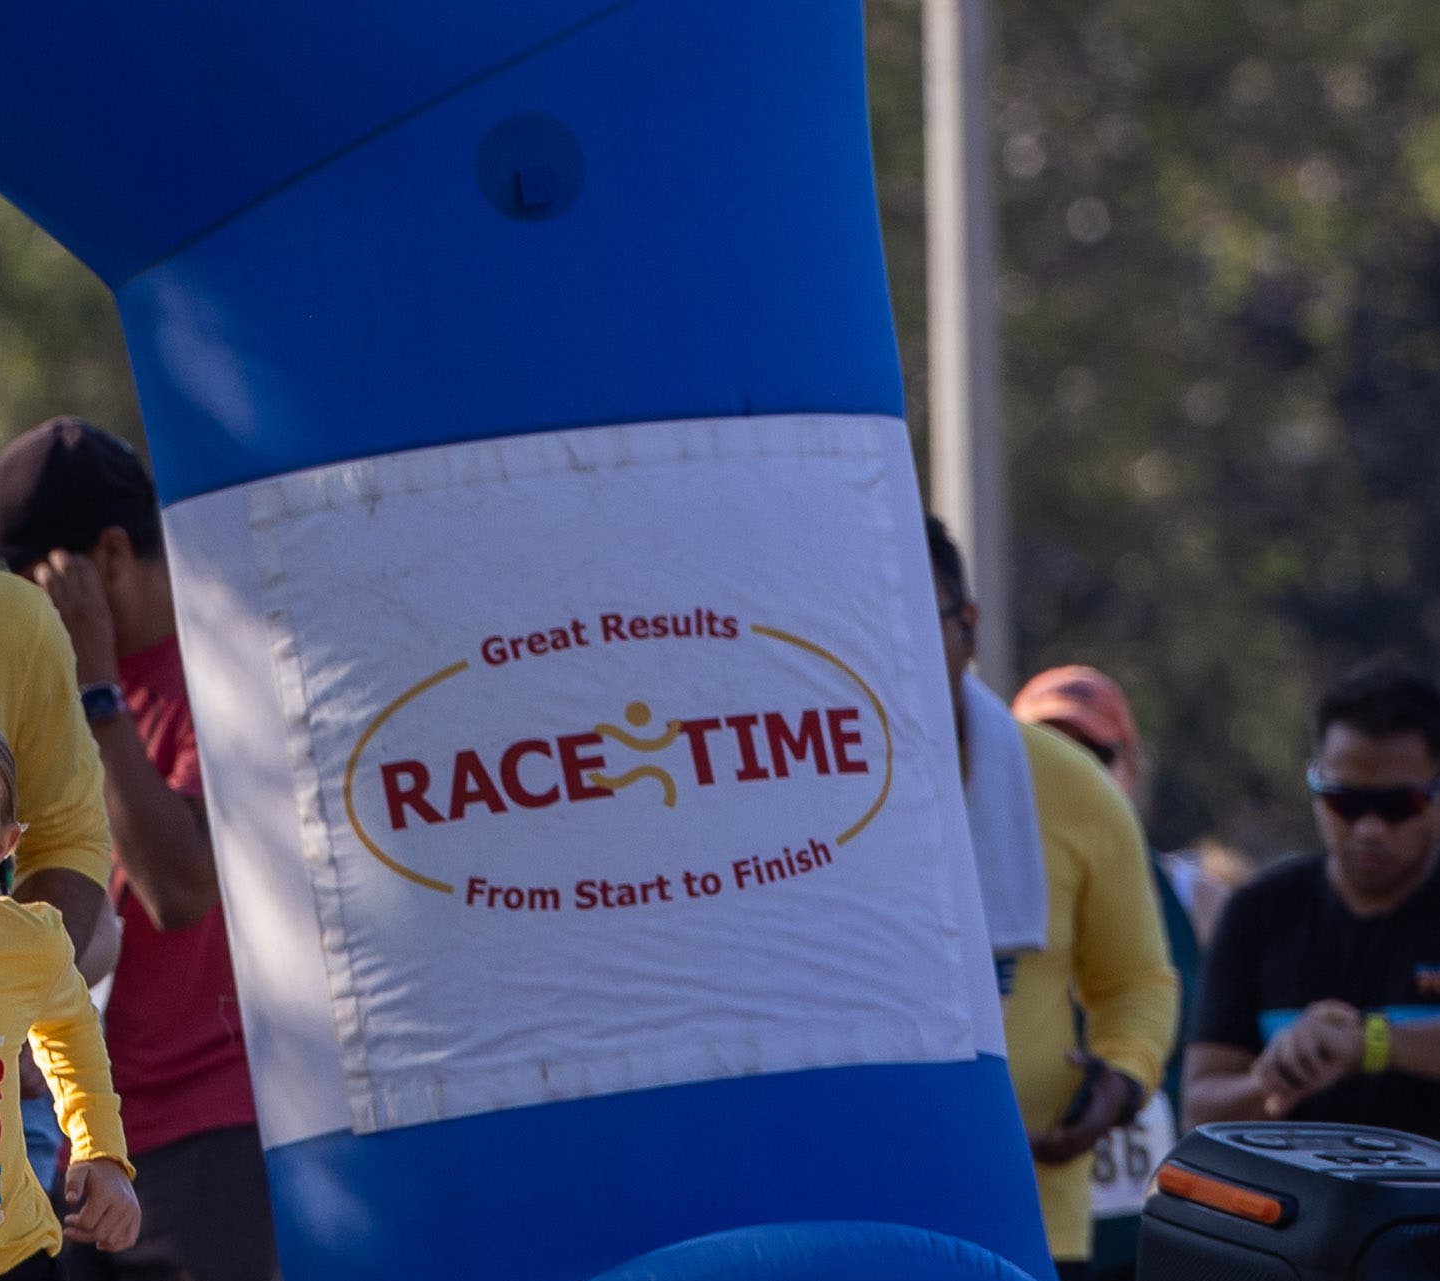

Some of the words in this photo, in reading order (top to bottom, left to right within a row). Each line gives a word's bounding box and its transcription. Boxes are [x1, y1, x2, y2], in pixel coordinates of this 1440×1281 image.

[481, 621, 587, 667] Great
[600, 607, 739, 642] Results
[381, 731, 615, 831] RACE
[677, 707, 870, 787] TIME
[466, 876, 561, 912] From
[575, 873, 673, 910] Start
[683, 872, 723, 900] to
[732, 837, 834, 892] Finish
